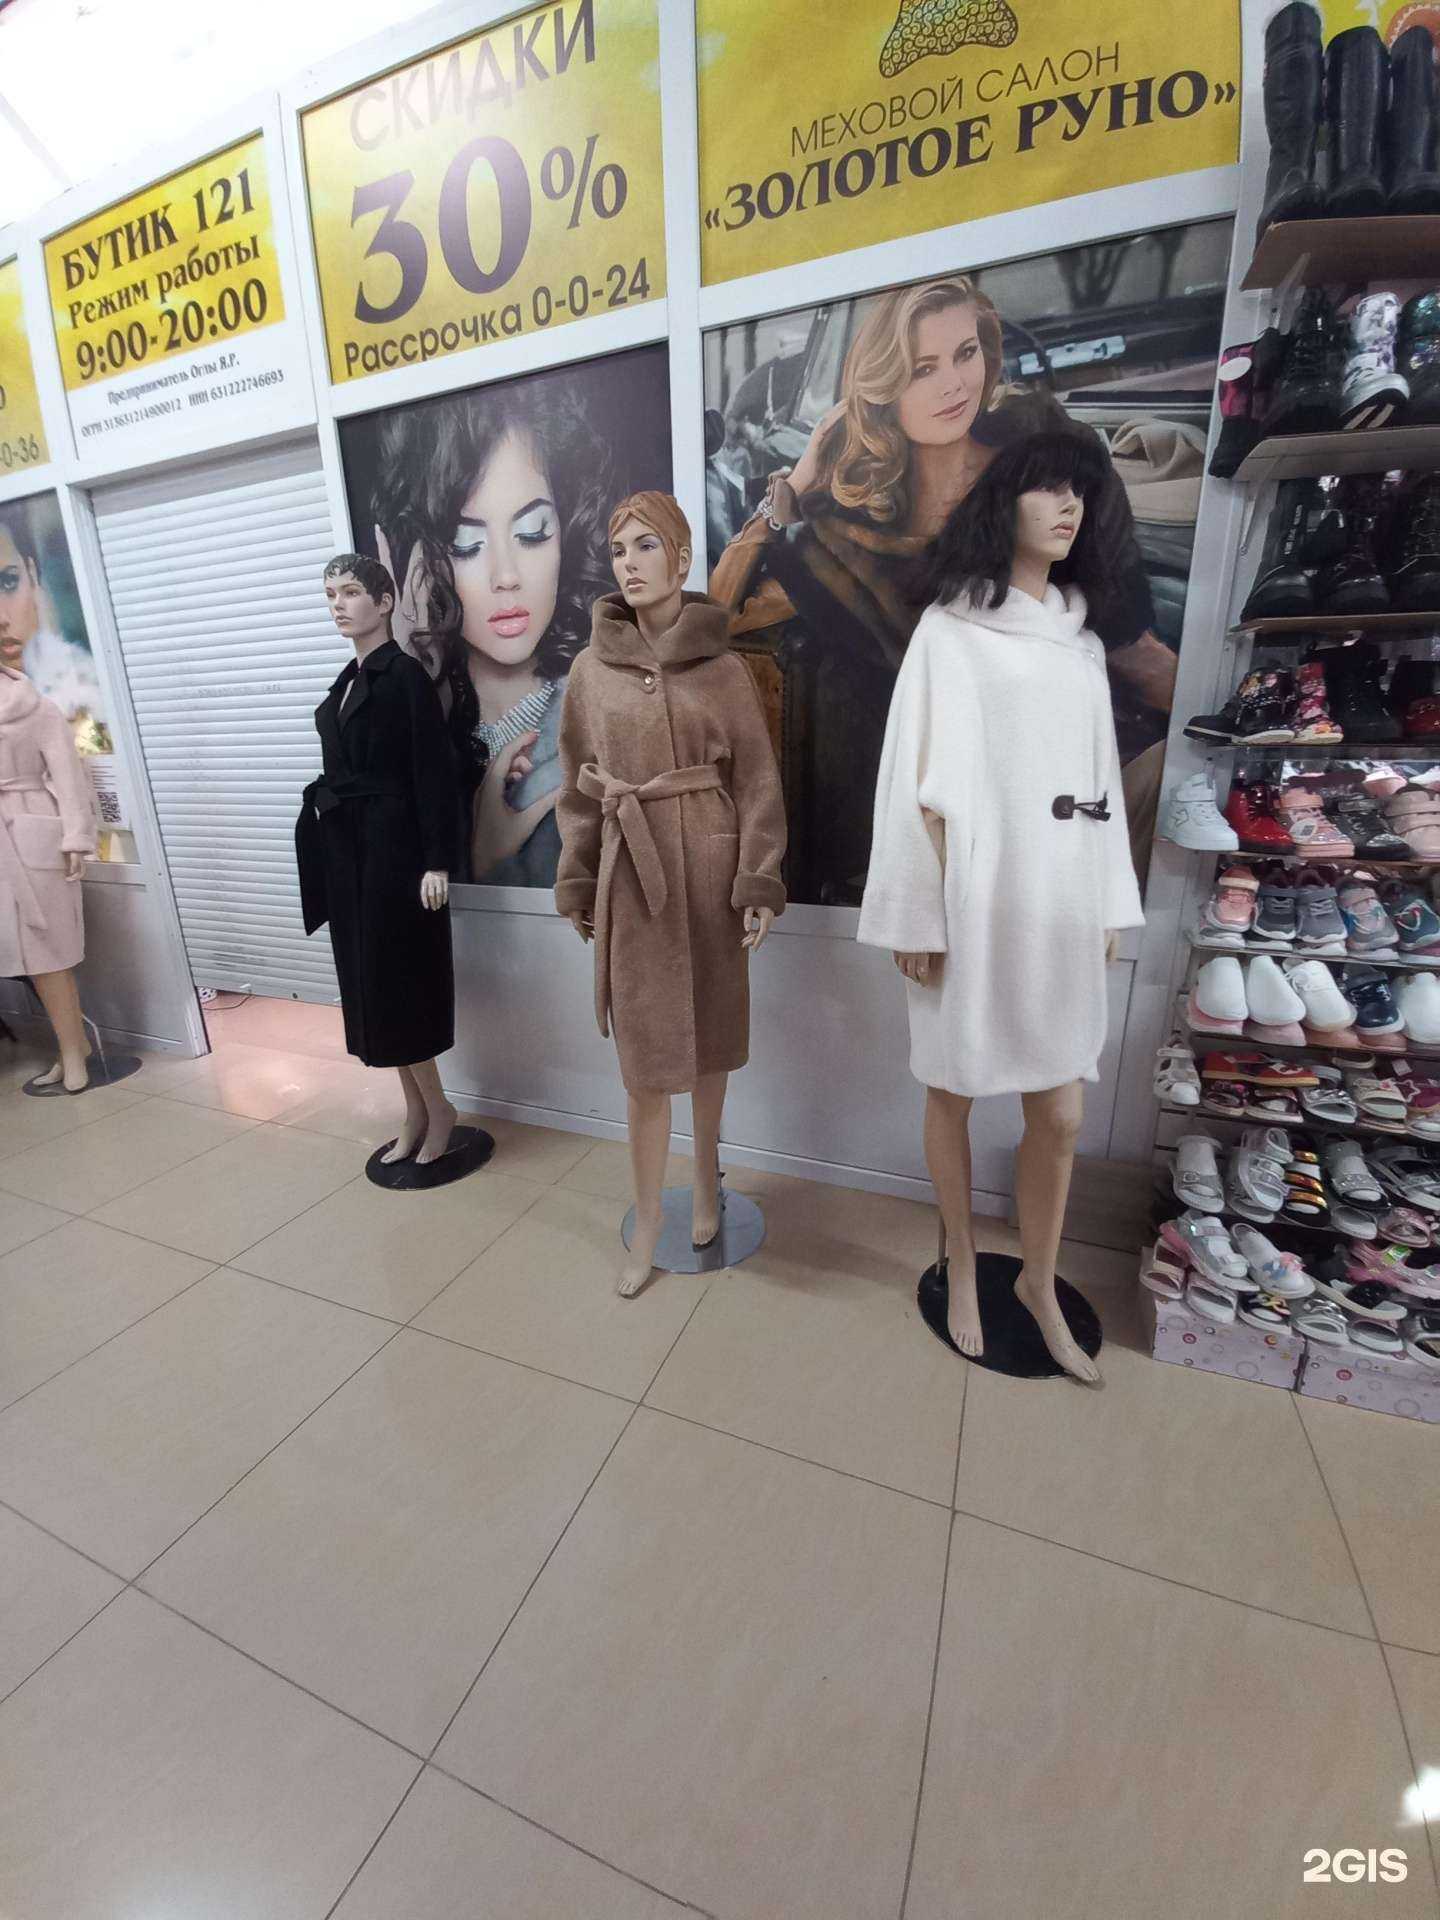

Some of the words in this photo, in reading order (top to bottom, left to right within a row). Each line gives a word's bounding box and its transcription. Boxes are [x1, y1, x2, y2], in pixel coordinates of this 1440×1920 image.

[349, 0, 596, 152] СКИДКИ
[791, 77, 964, 159] МЕХОВОЙ
[976, 42, 1120, 102] САЛОН
[704, 115, 995, 232] «ЗОЛОТОЕ
[1014, 69, 1238, 154] РУНО»
[61, 202, 179, 291] БУТИК
[192, 167, 256, 234] 121
[68, 279, 150, 330] Режим
[155, 234, 261, 304] работы
[350, 134, 628, 324] 30%
[75, 277, 268, 381] 9:00-20:00
[343, 303, 522, 377] Рассрочка
[532, 257, 650, 327] 0-0-24
